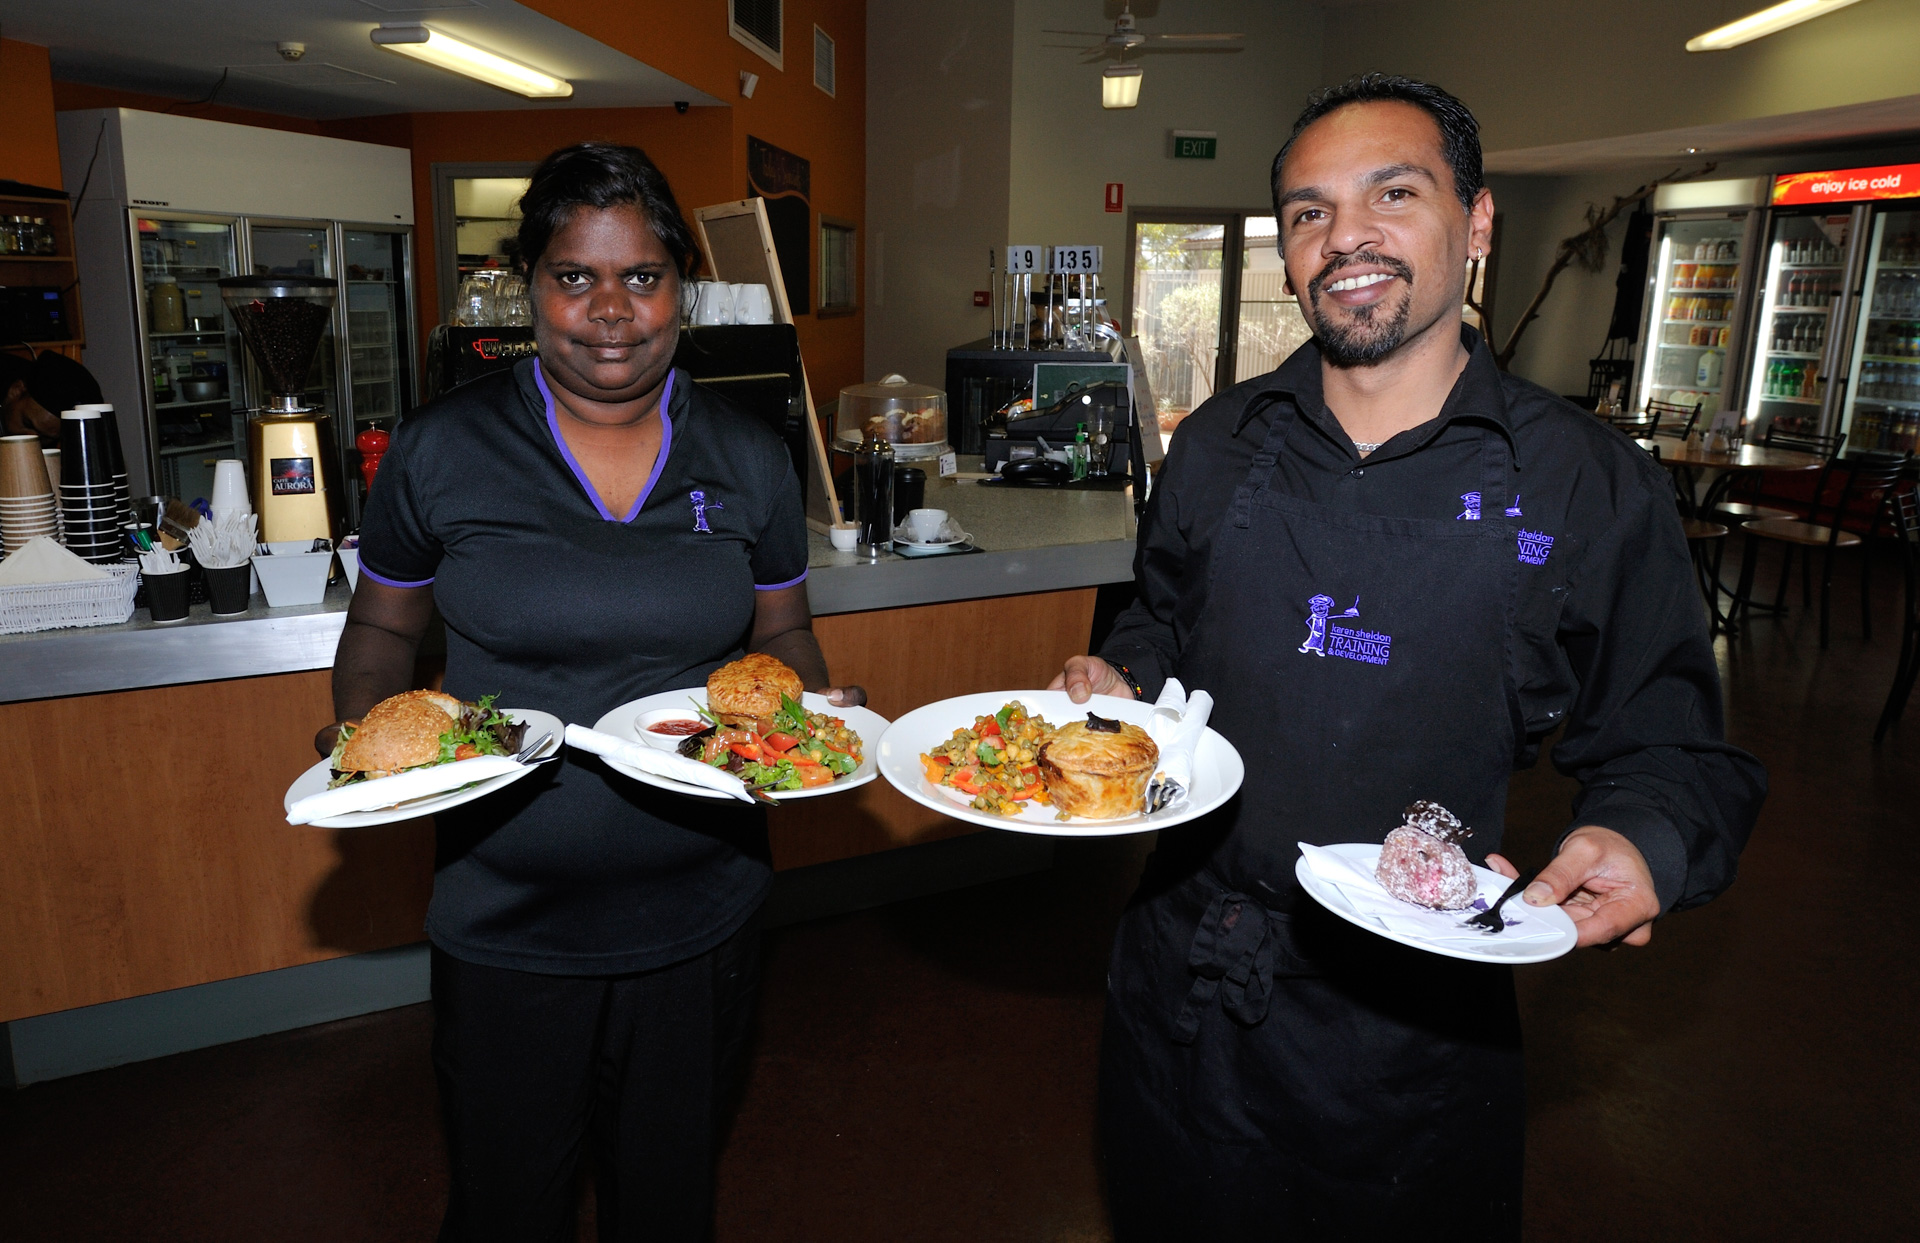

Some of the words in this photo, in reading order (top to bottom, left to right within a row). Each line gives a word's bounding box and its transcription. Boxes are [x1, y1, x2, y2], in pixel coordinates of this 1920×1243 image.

[1182, 140, 1208, 156] EXIT
[1811, 180, 1847, 194] enjoy
[1848, 178, 1868, 191] ice
[1870, 174, 1902, 189] cold
[1025, 250, 1033, 268] 9
[274, 480, 314, 491] AURORA
[1331, 622, 1355, 637] karen
[1355, 628, 1392, 643] sheldon
[1329, 635, 1391, 658] TRAINING
[1327, 647, 1335, 656] &
[1334, 648, 1390, 666] DEVELOPMENT
